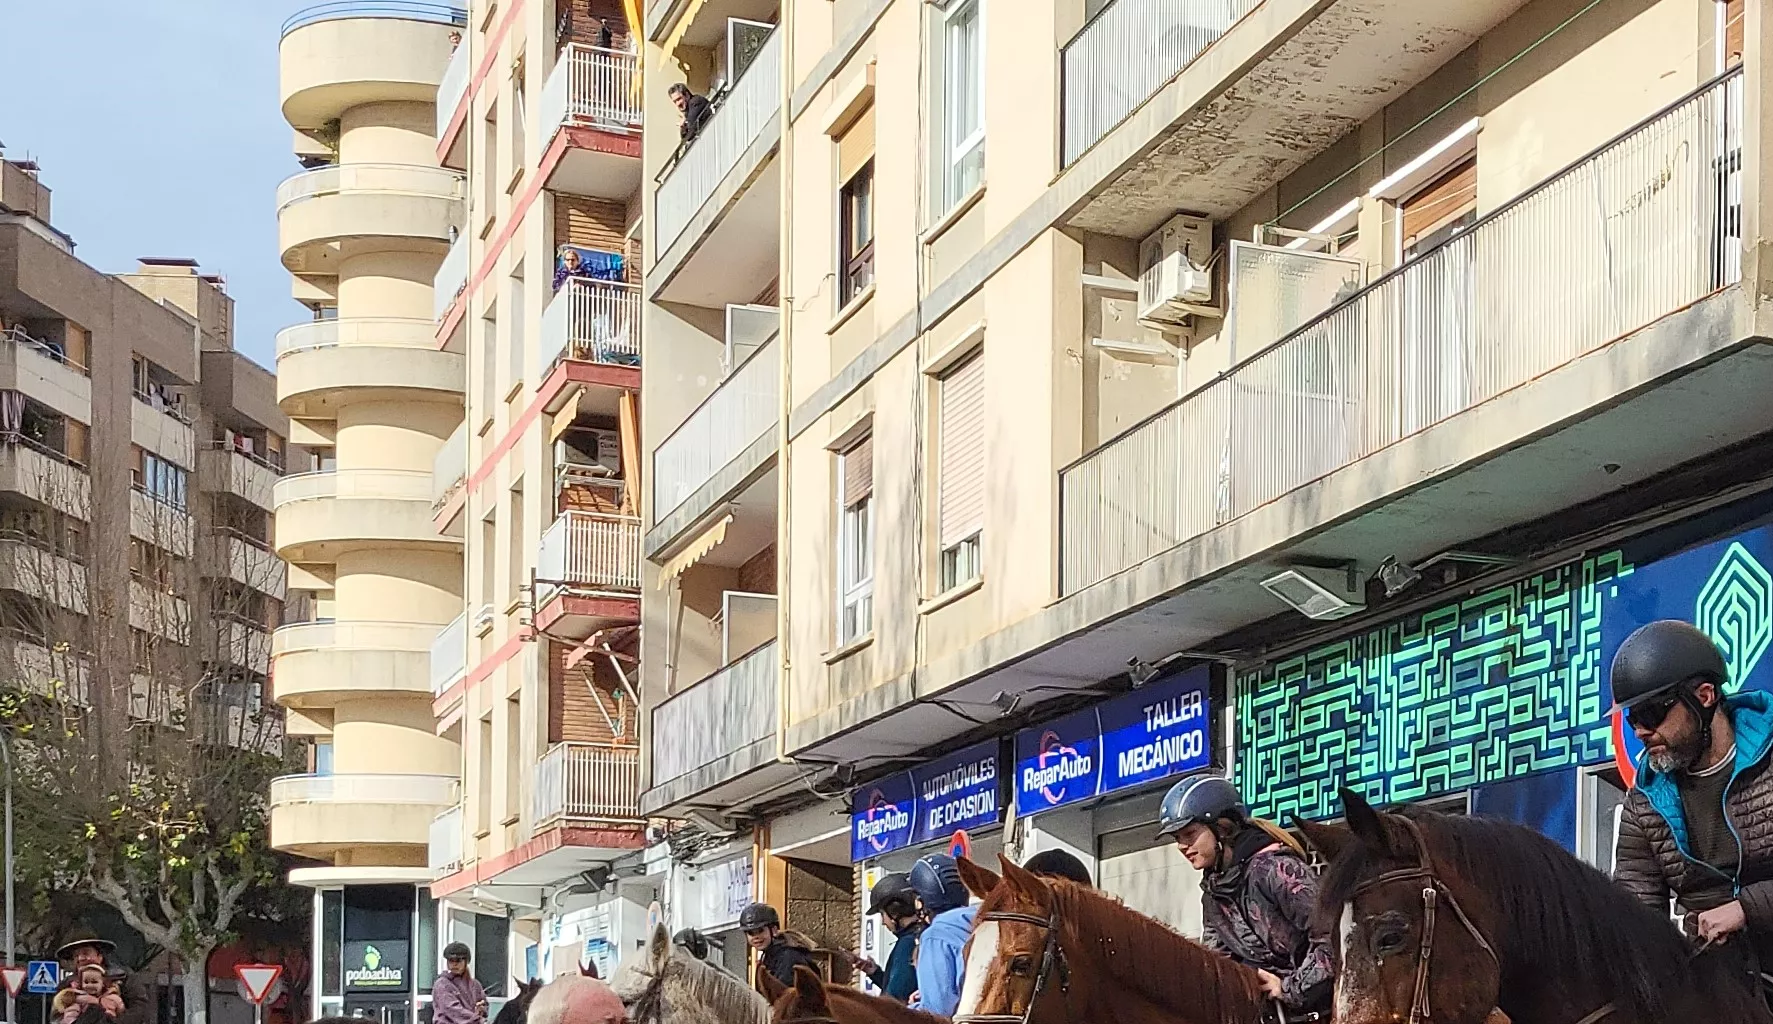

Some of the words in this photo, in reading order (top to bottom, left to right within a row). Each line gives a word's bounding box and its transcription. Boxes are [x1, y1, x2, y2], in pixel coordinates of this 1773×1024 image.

[1143, 690, 1203, 733] TALLER
[1023, 755, 1092, 794] ReparAuto
[1118, 729, 1203, 778] MECÁNICO
[922, 757, 995, 801] AUTOMÓVILES
[857, 811, 909, 843] ReparAuto
[929, 806, 944, 831] DE
[945, 788, 995, 824] OCASIÓN
[345, 966, 402, 986] podoactiva
